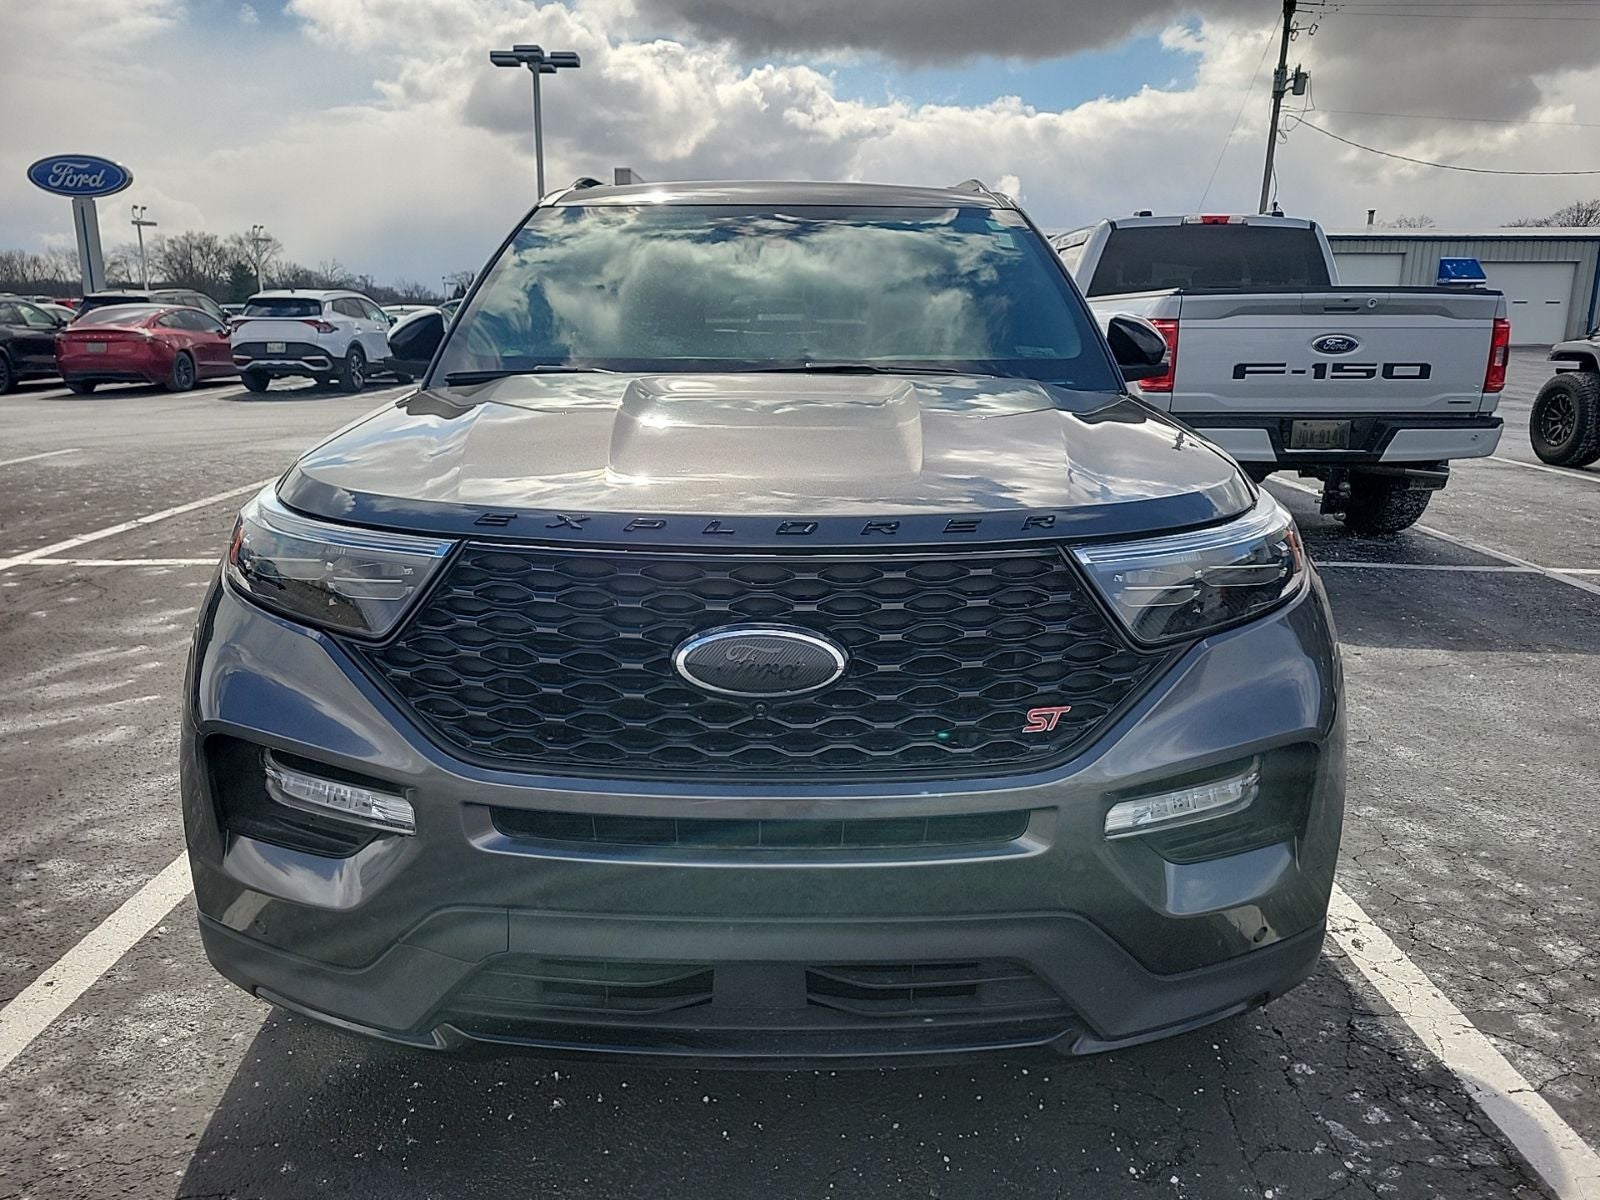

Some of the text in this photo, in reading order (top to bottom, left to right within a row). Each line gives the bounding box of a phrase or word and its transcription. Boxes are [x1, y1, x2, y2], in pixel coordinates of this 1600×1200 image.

[47, 162, 106, 187] Ford
[1323, 338, 1349, 350] Ford
[1232, 363, 1432, 379] F-150
[474, 512, 1056, 534] EXPLORER
[719, 644, 802, 681] Ford
[1022, 706, 1071, 733] ST
